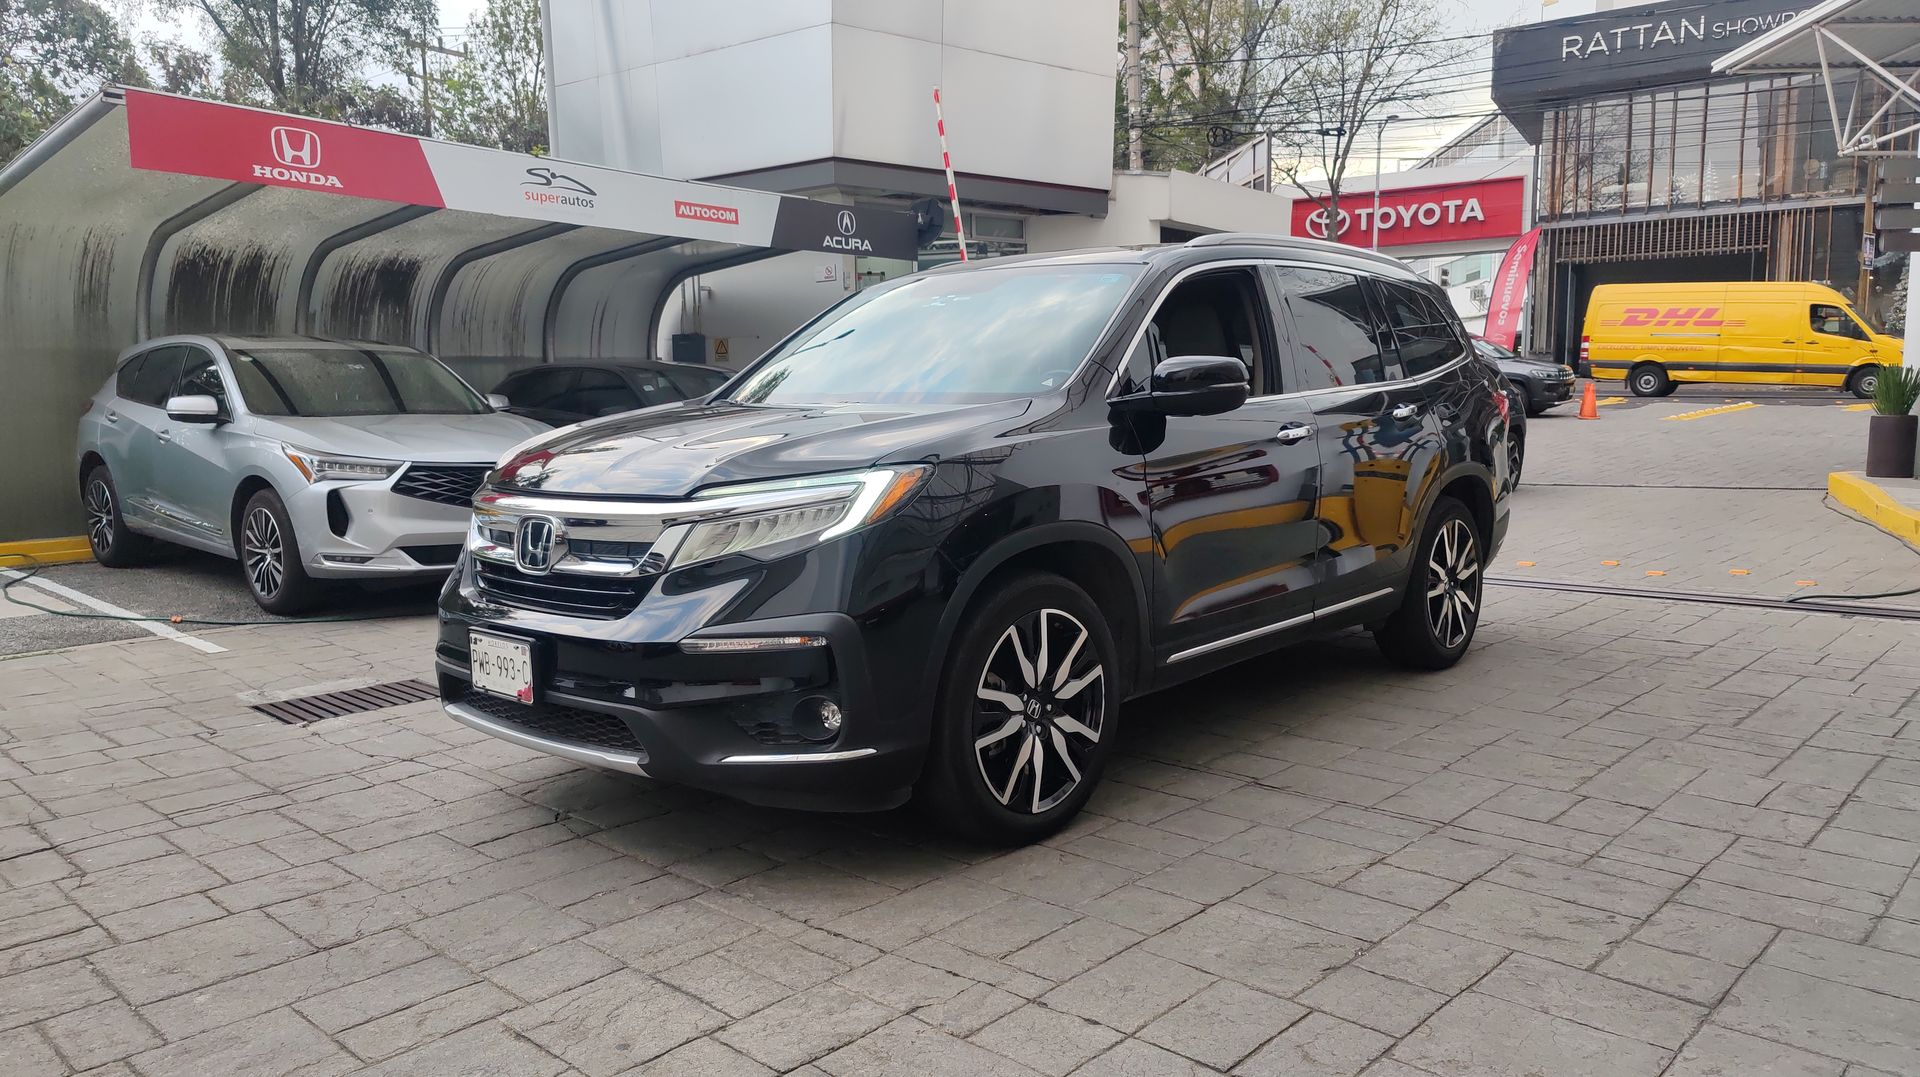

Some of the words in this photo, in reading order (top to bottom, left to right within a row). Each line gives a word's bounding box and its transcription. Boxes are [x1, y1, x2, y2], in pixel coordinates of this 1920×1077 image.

[1562, 15, 1705, 62] RATTAN
[1711, 10, 1809, 39] SHOWR
[252, 164, 343, 188] HONDA
[524, 191, 594, 208] superautos
[678, 204, 736, 221] AUTOCOM
[1355, 198, 1485, 231] TOYOTA
[822, 235, 872, 251] ACURA
[1619, 307, 1725, 327] DHL
